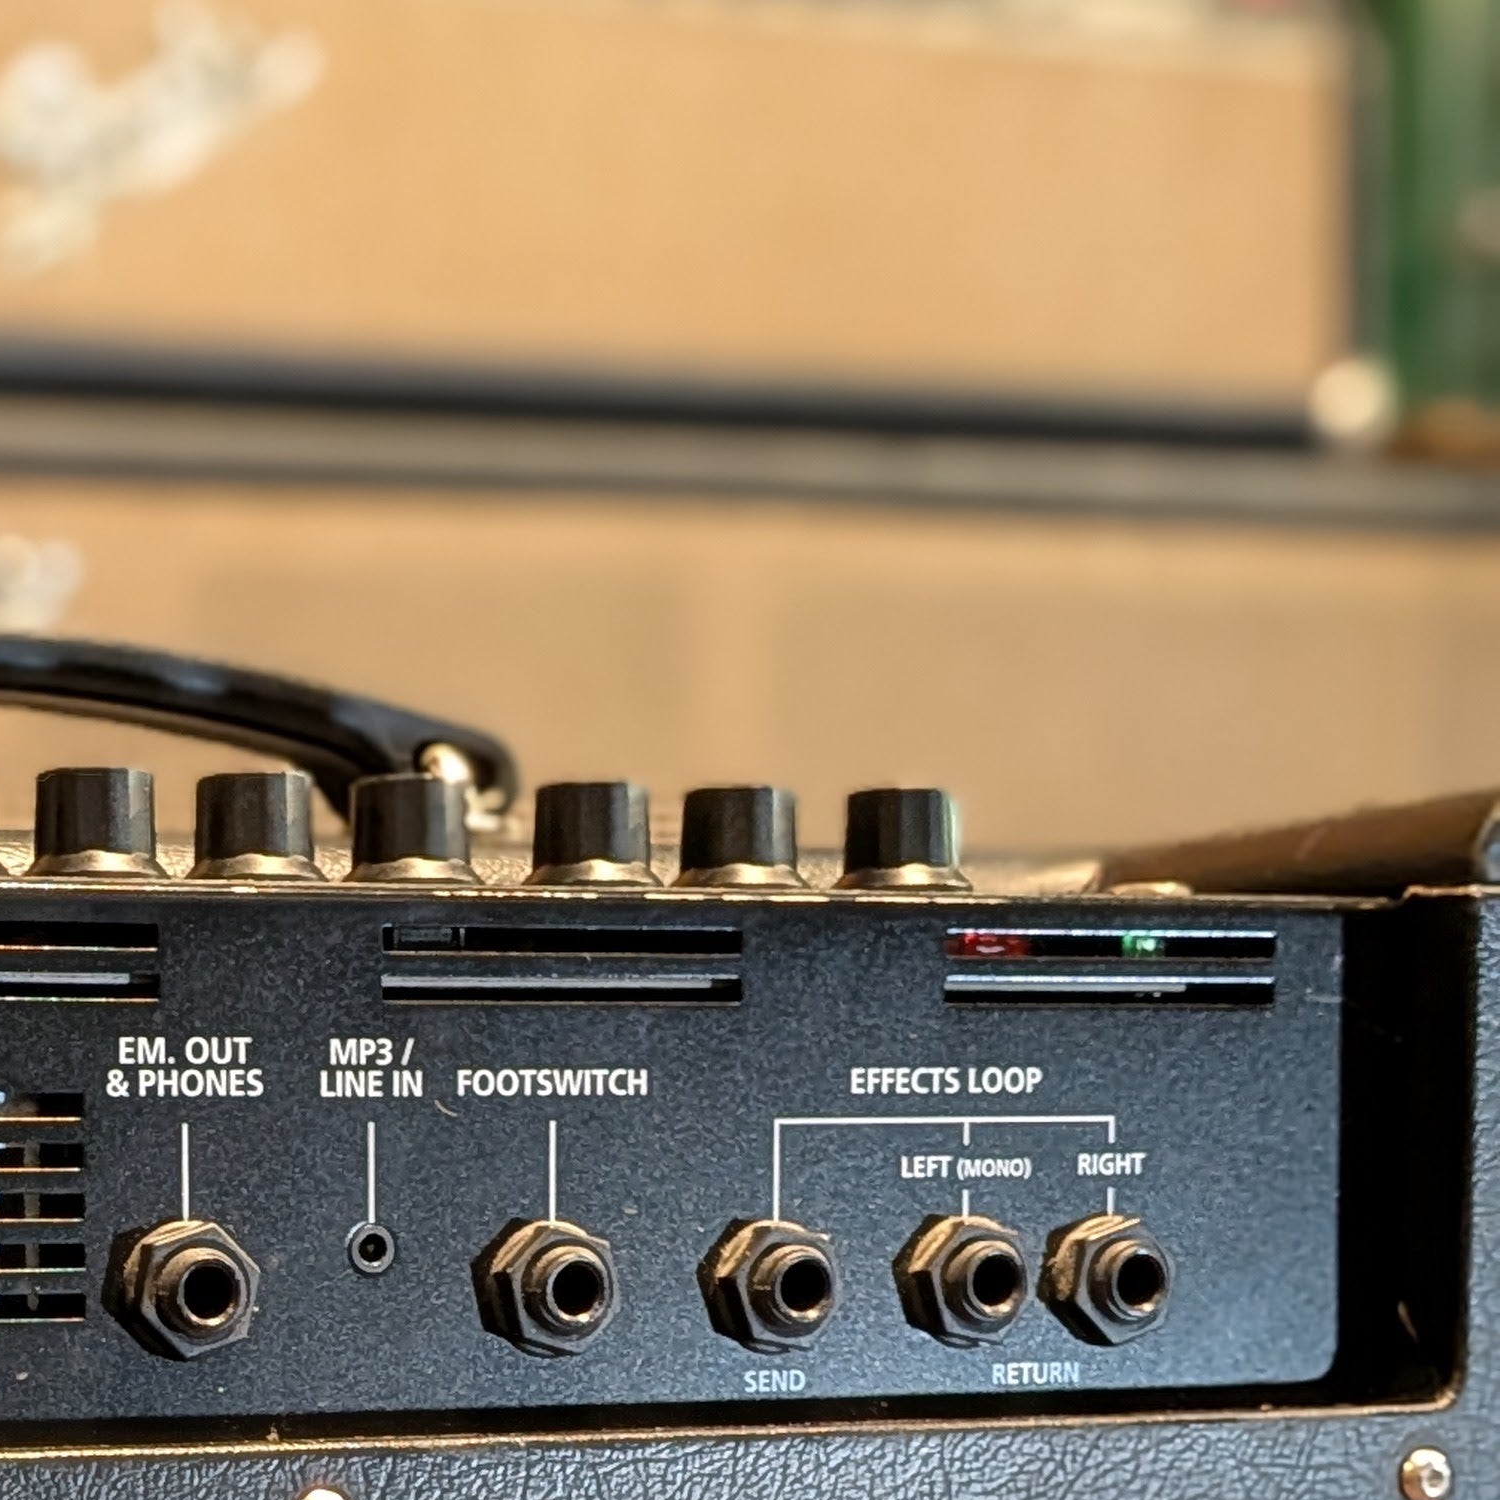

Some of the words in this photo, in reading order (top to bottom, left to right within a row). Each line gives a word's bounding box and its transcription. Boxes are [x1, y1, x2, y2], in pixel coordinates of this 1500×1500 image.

[119, 1037, 175, 1064] EM.
[186, 1037, 252, 1064] OUT
[330, 1038, 392, 1065] MP3
[401, 1038, 414, 1065] /
[106, 1069, 129, 1097] &
[139, 1069, 263, 1097] PHONES
[320, 1070, 383, 1097] LINE
[393, 1070, 422, 1097] IN
[458, 1069, 647, 1096] FOOTSWITCH
[851, 1067, 960, 1094] EFFECTS
[968, 1067, 1042, 1093] LOOP
[901, 1156, 953, 1178] LEFT
[957, 1158, 1031, 1180] (MONO)
[1078, 1153, 1146, 1175] RIGHT
[744, 1370, 805, 1392] SEND
[993, 1362, 1079, 1384] RETURN
